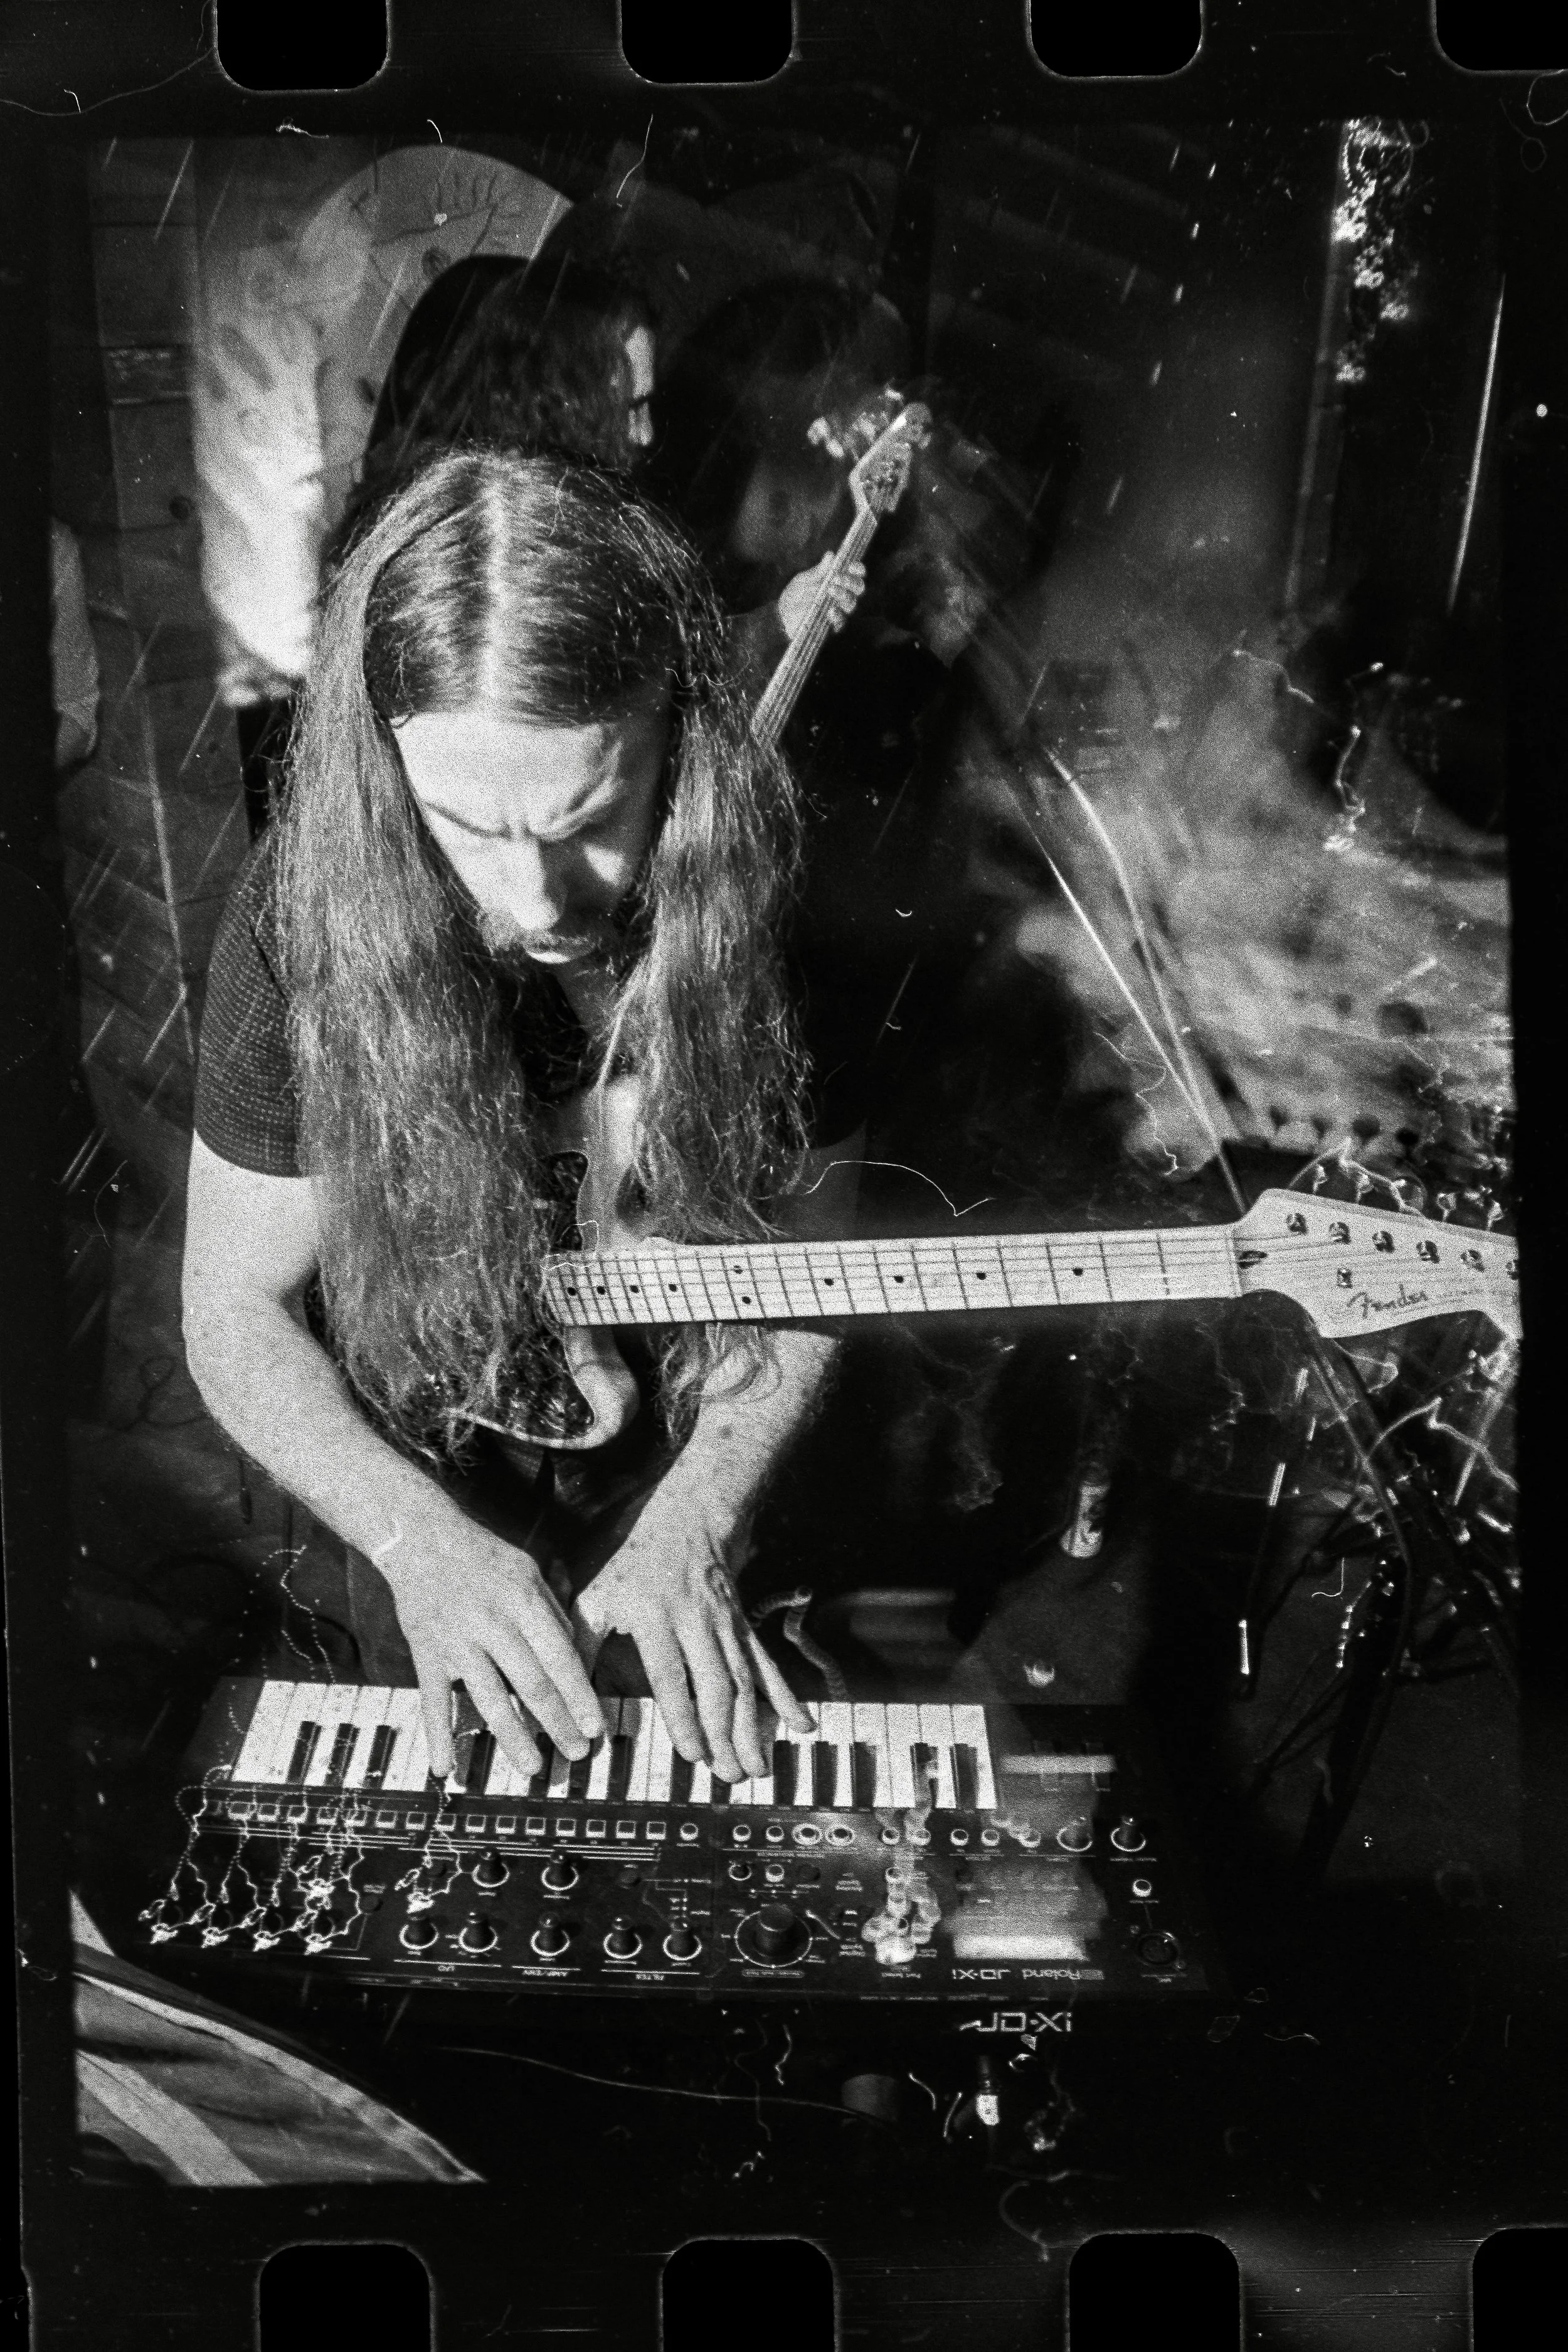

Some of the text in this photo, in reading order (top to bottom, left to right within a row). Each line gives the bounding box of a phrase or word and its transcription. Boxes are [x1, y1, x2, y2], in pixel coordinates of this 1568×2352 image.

[1347, 1284, 1429, 1318] Fender
[952, 1969, 1080, 1980] Roland JD-Xi
[976, 2012, 1072, 2032] JD-Xi
